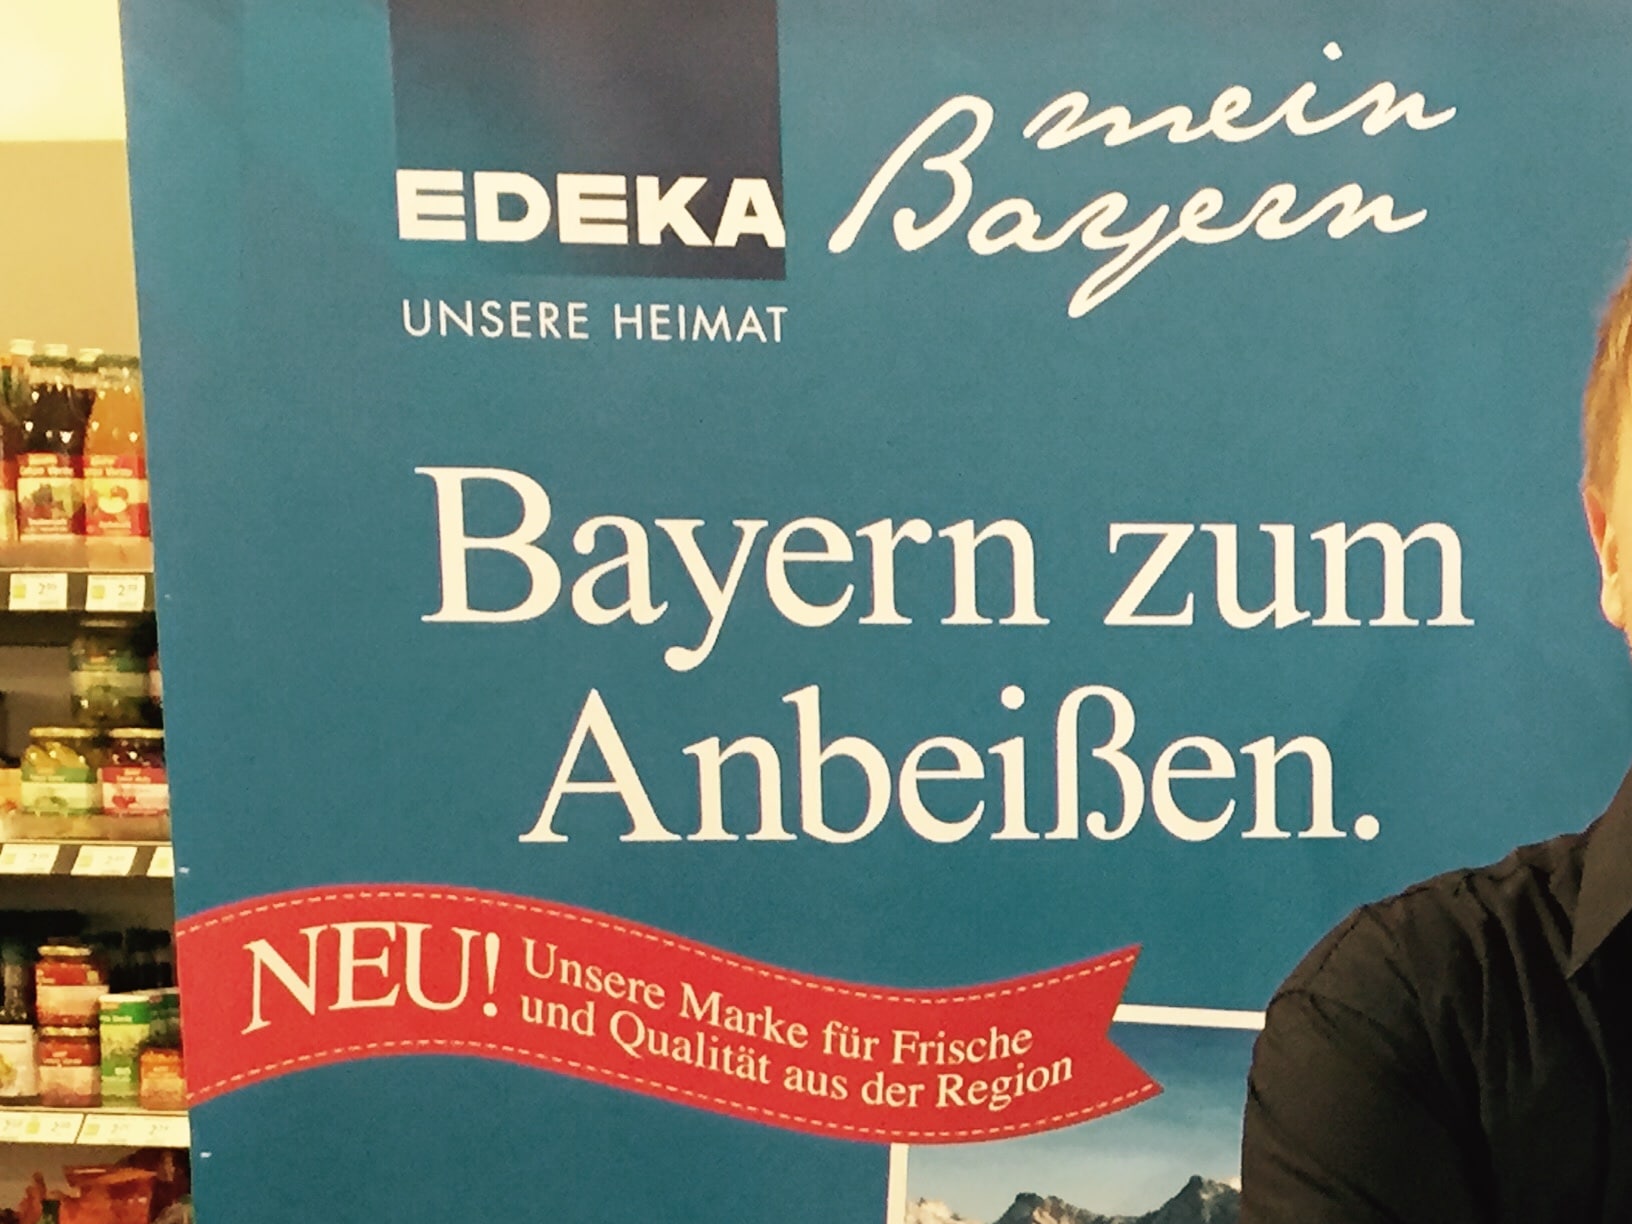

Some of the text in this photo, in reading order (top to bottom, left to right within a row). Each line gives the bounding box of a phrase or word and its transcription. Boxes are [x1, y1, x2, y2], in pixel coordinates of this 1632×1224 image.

[1023, 40, 1457, 151] mein
[396, 169, 787, 249] EDEKA
[828, 94, 1427, 318] Bayern
[402, 299, 789, 343] UNSERE HEIMAT
[413, 466, 1475, 672] Bayern zum
[518, 685, 1381, 844] Anbeißen.
[240, 920, 502, 1036] NEU!
[521, 936, 1034, 1066] Unsere Marke für Frische
[520, 995, 1073, 1112] und Qualität aus der Region
